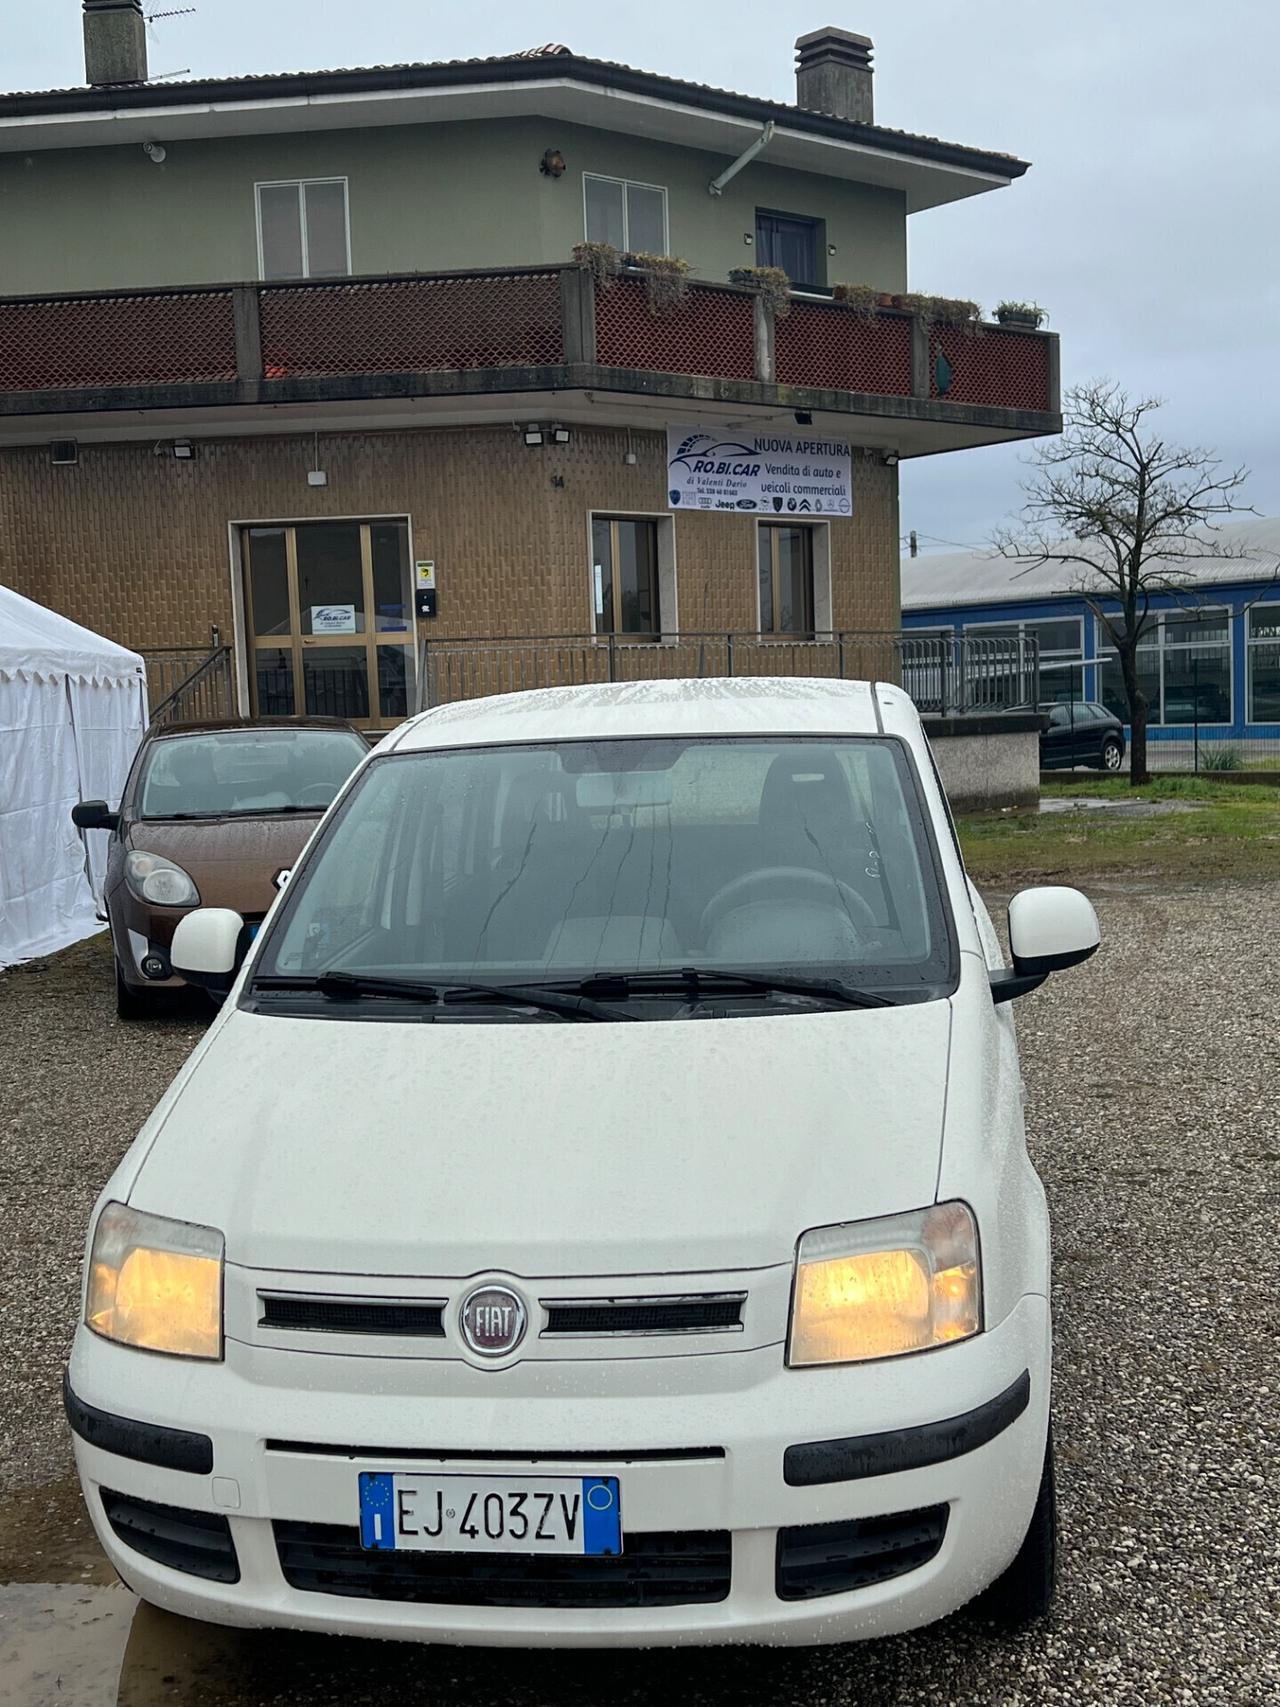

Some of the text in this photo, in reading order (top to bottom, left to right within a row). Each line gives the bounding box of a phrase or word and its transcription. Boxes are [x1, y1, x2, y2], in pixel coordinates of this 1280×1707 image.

[754, 438, 850, 456] NUOVA APERTURA
[693, 460, 760, 476] RO.BI.CAR
[765, 463, 842, 478] Vendita di auto e
[686, 476, 695, 485] di
[697, 477, 724, 487] Valenti
[761, 481, 846, 496] veicoli commerciali
[715, 500, 735, 510] Jeep
[476, 1306, 512, 1337] FIAT
[398, 1489, 581, 1540] EJ 403ZV
